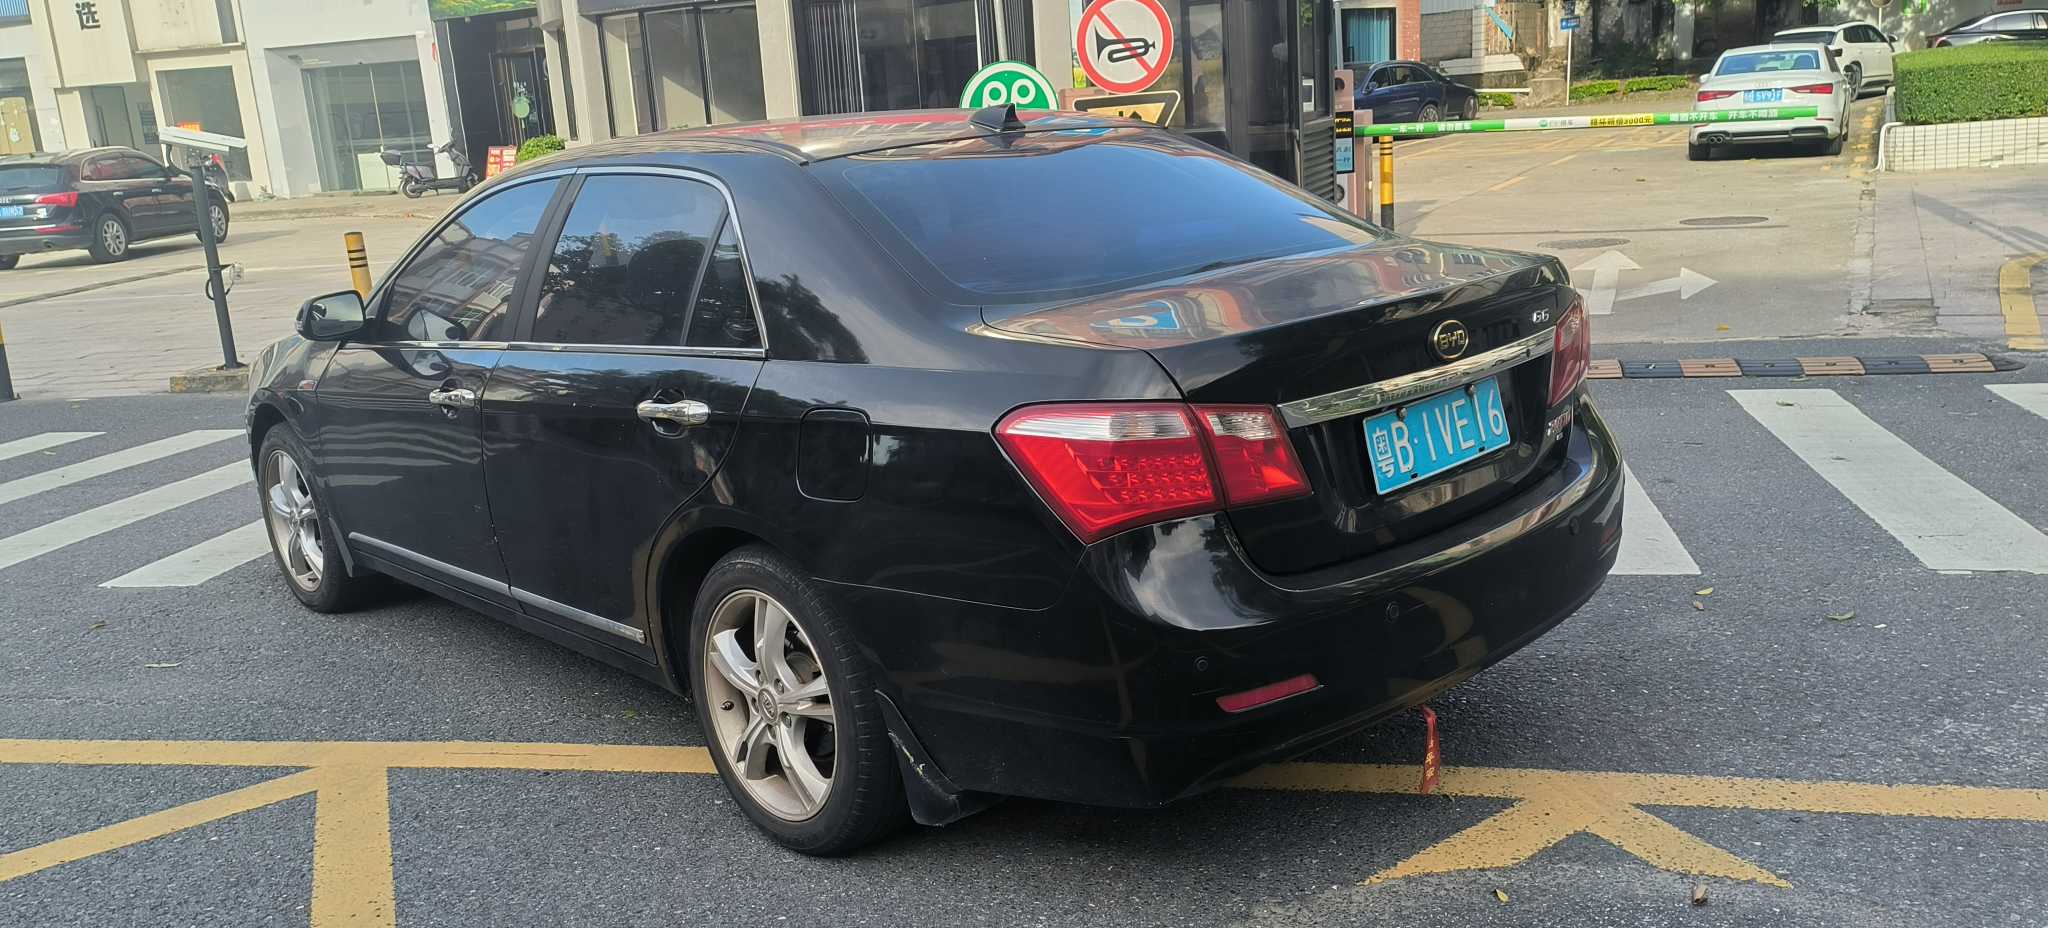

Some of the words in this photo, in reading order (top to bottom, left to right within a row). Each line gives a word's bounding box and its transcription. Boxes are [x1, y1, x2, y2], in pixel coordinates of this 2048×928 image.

[75, 1, 101, 30] 选
[1439, 329, 1465, 349] BYD
[1372, 388, 1504, 478] 粤B·1VE16
